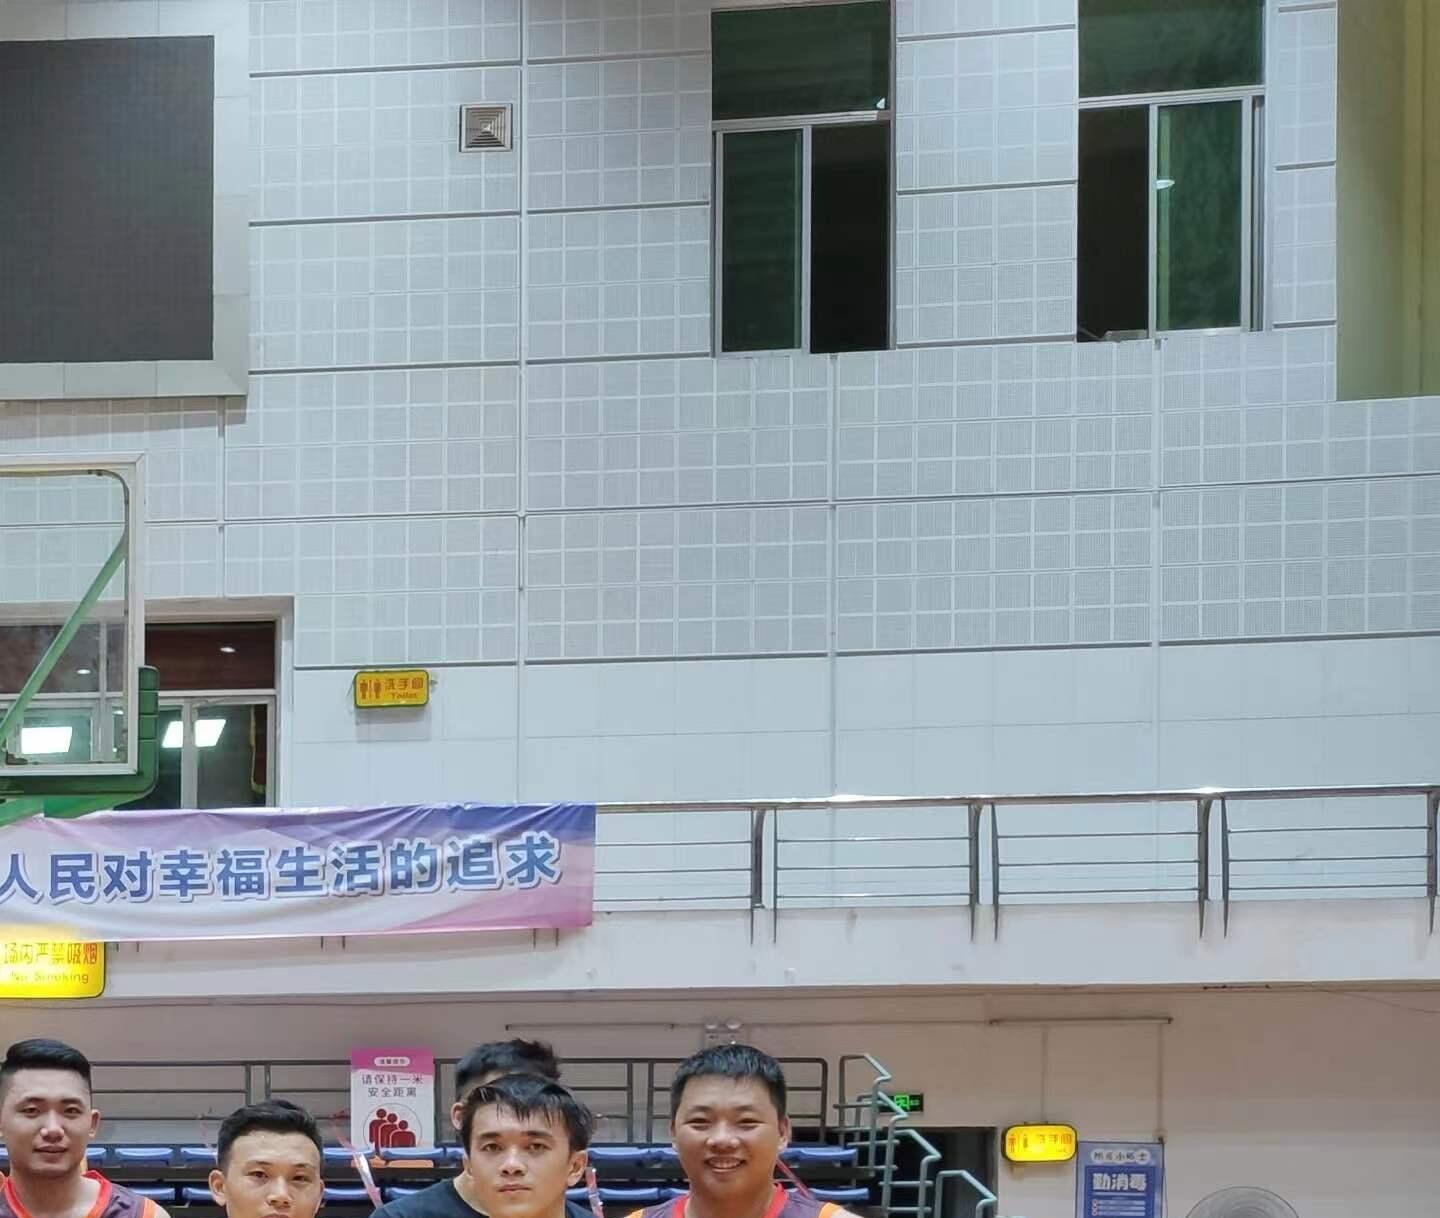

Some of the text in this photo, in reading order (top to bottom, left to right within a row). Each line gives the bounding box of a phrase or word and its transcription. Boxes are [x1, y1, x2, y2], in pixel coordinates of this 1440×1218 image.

[4, 942, 98, 965] 场内严禁吸烟
[34, 972, 90, 984] Smoking
[361, 1073, 424, 1086] 请保持一米
[367, 1086, 418, 1098] 安全距离
